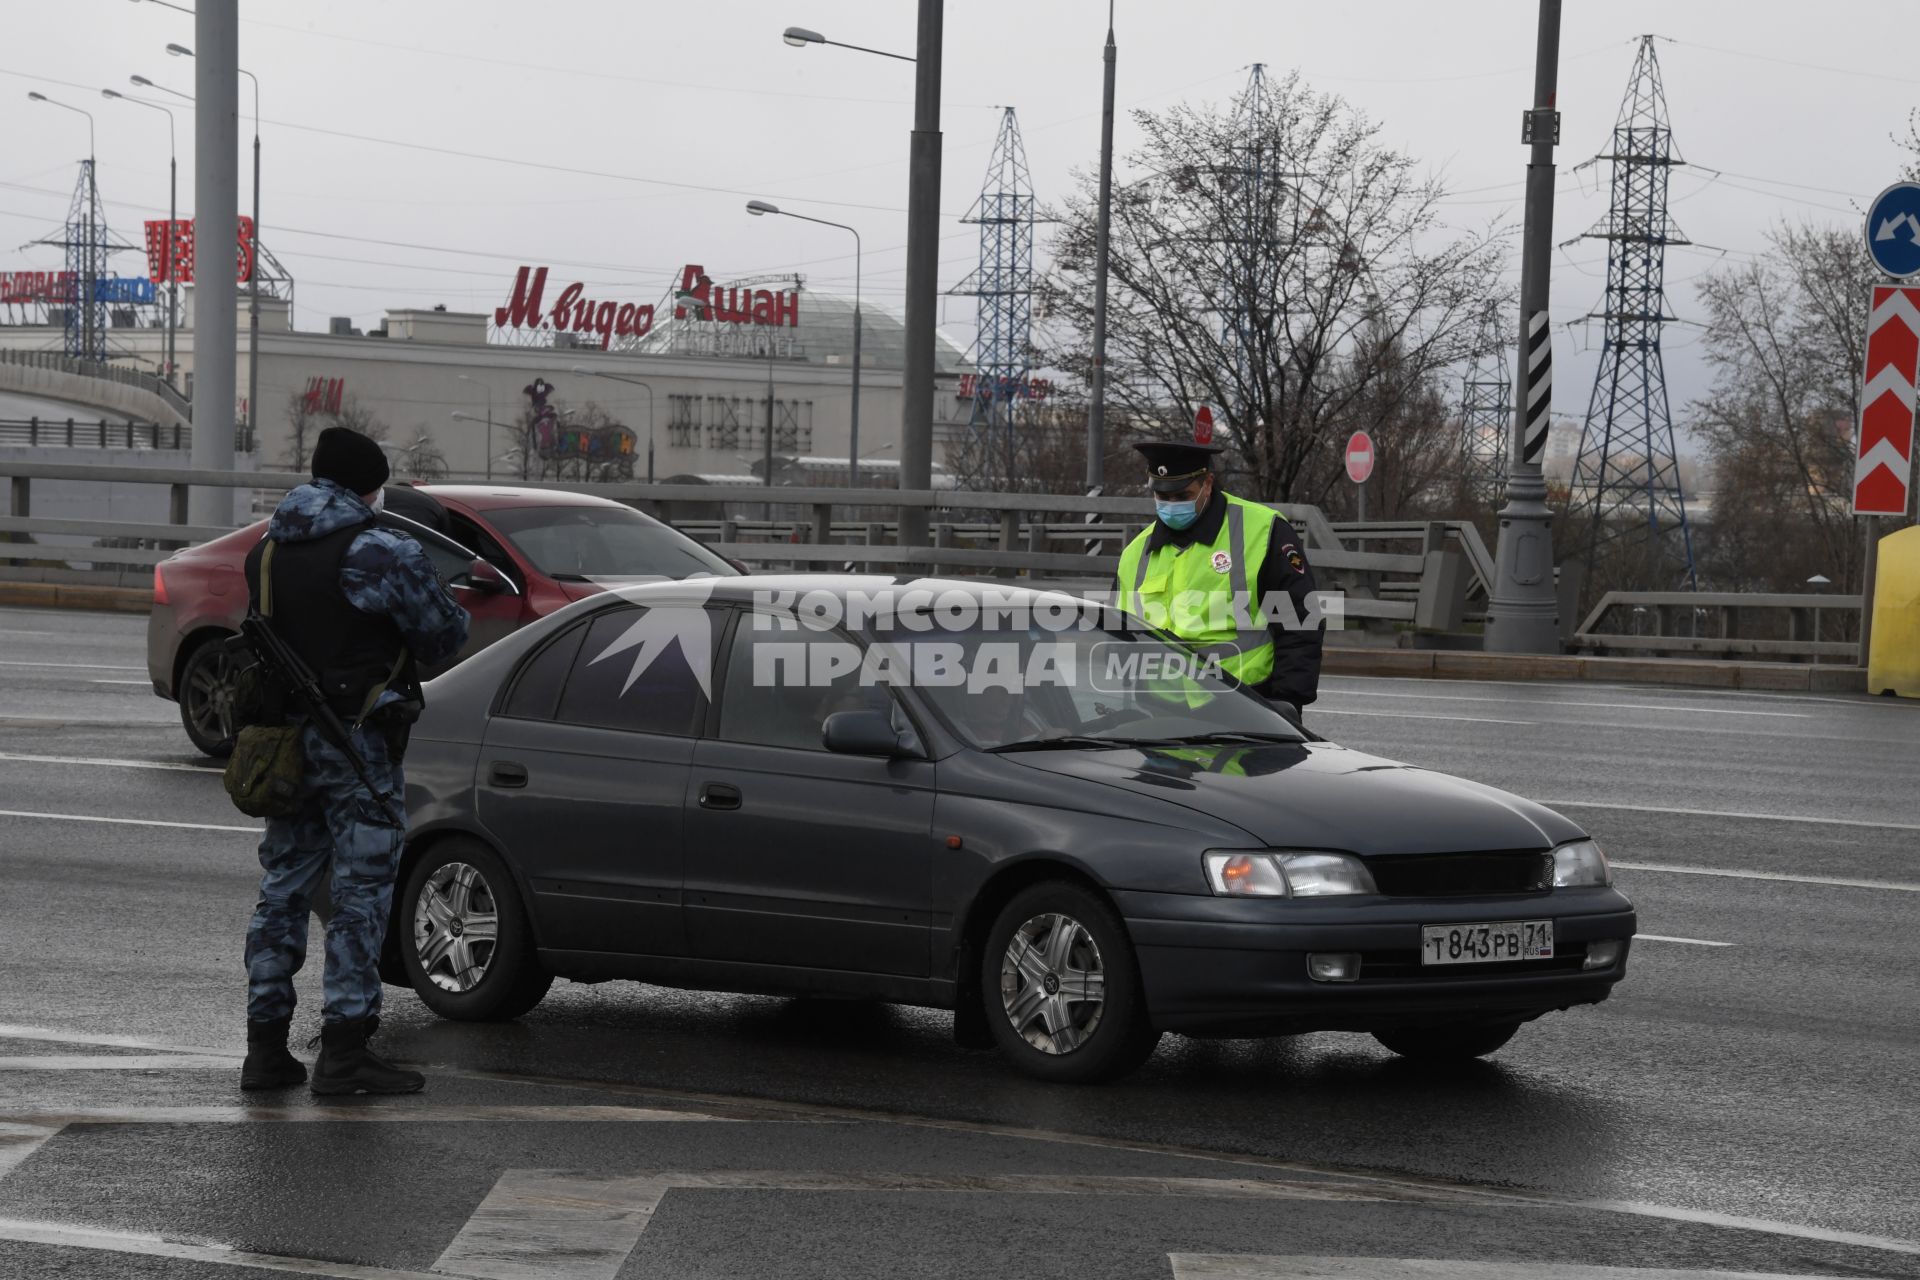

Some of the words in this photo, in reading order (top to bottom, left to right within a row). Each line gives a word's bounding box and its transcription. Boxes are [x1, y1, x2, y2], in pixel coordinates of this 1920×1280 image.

[144, 215, 254, 283] VES
[674, 264, 798, 327] Ашан
[1196, 420, 1211, 438] STOP
[1525, 923, 1546, 947] 71
[1525, 947, 1539, 956] RUS
